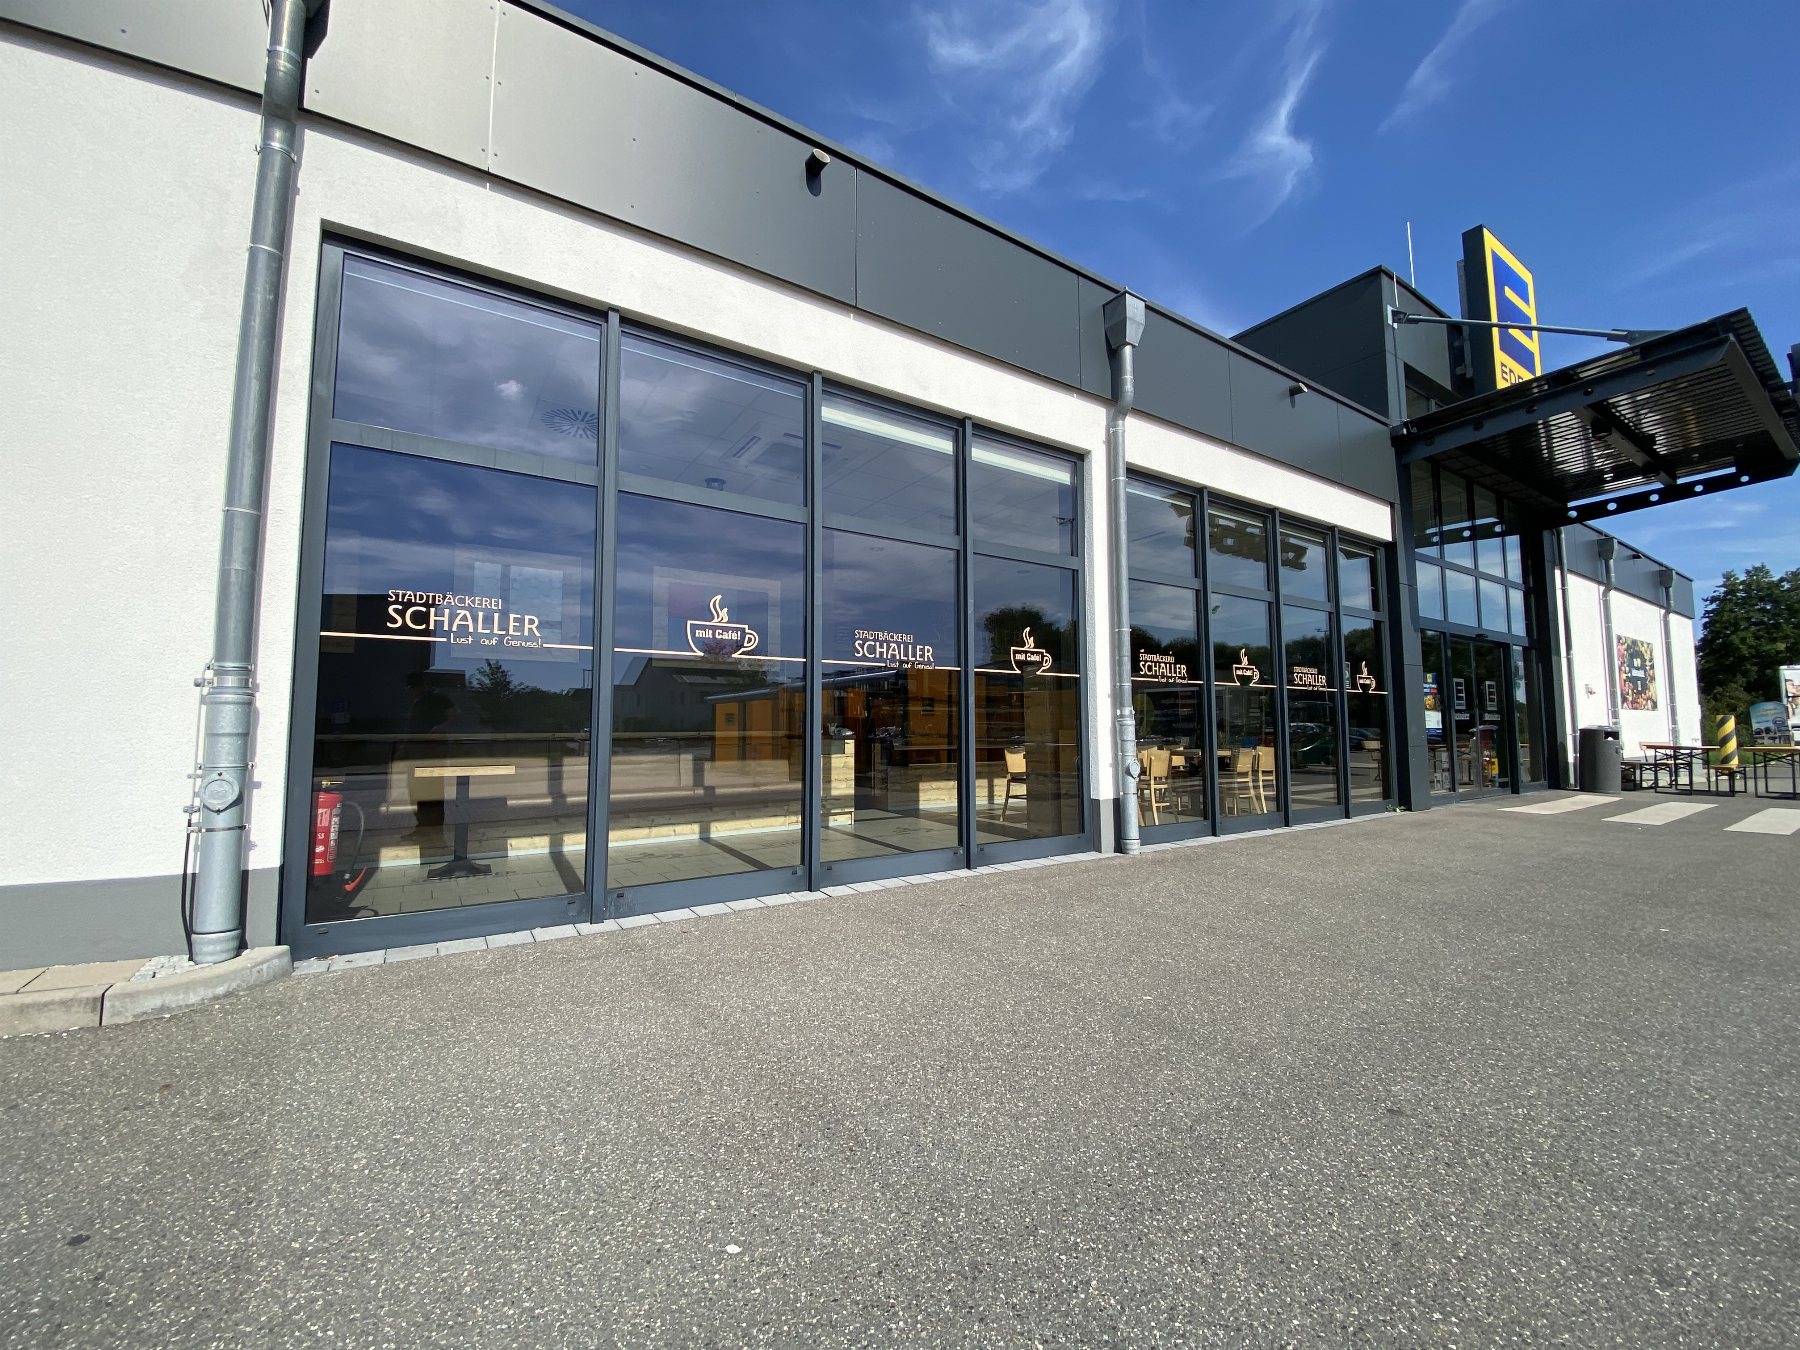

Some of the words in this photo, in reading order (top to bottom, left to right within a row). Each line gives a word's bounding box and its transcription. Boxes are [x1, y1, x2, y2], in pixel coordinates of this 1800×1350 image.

[387, 589, 503, 610] STADTBÄCKEREI
[386, 604, 542, 637] SCHALLER
[450, 633, 474, 645] Lust
[480, 636, 499, 646] auf
[503, 636, 543, 649] Genuss!
[695, 628, 713, 639] mit
[715, 629, 741, 641] Café!
[854, 629, 914, 643] STADTBÄCKEREI
[854, 640, 934, 662] SCHALLER
[1139, 661, 1188, 678] SCHALLER
[1293, 673, 1327, 686] SCHALLER
